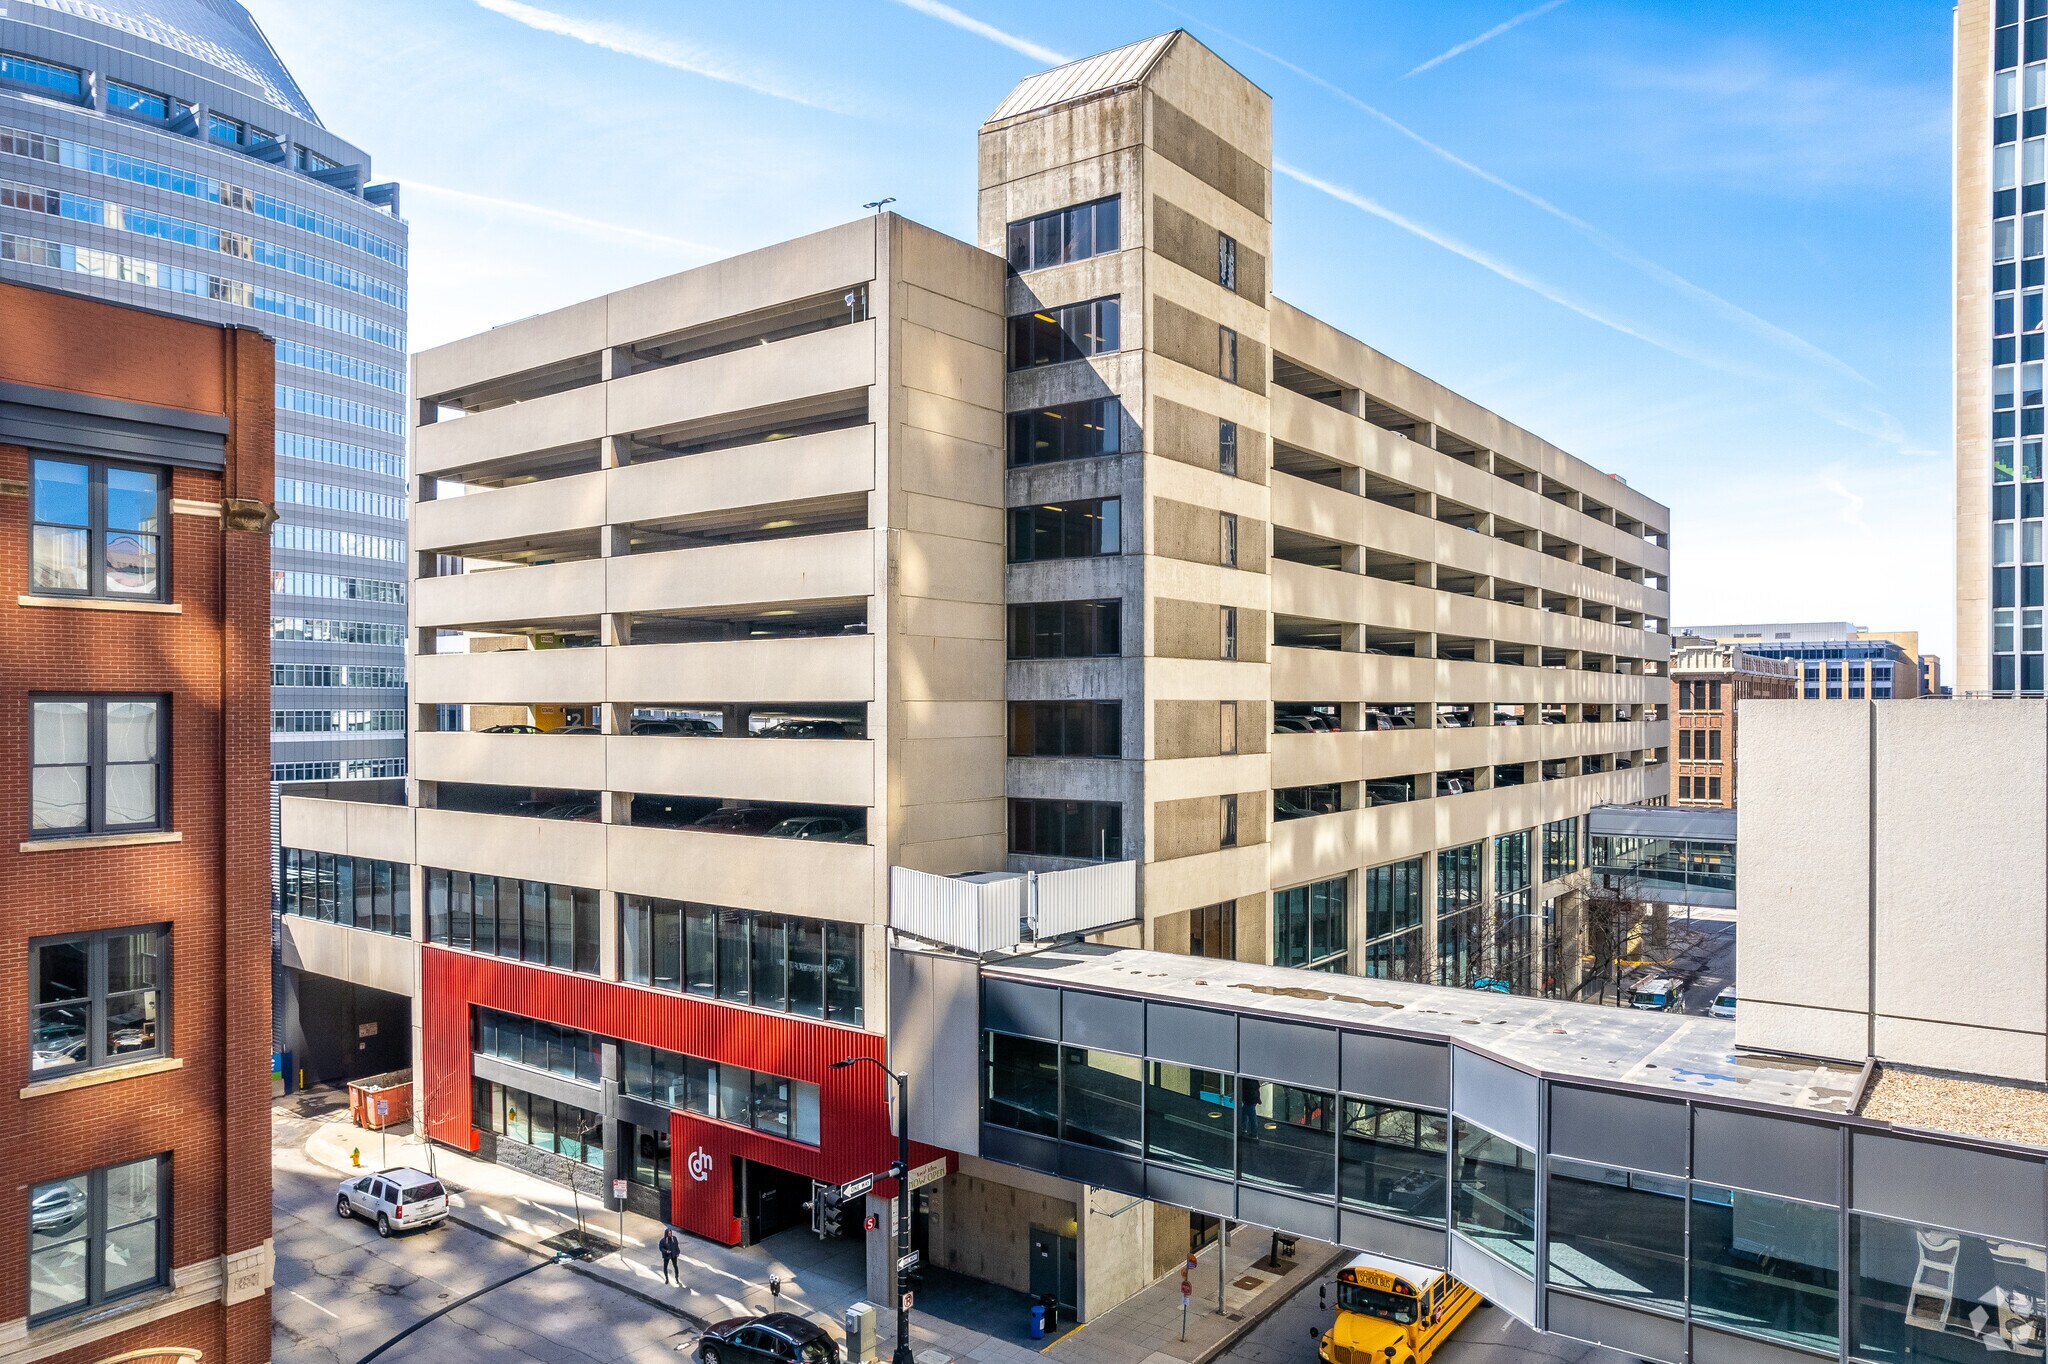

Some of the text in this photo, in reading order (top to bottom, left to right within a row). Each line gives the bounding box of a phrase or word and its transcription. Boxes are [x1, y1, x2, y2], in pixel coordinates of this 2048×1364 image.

[571, 713, 582, 727] 2
[850, 1179, 870, 1193] ONE WAY
[908, 1175, 926, 1190] NOW
[927, 1167, 945, 1182] OPEN
[1360, 1273, 1391, 1289] SCHOOL BUS
